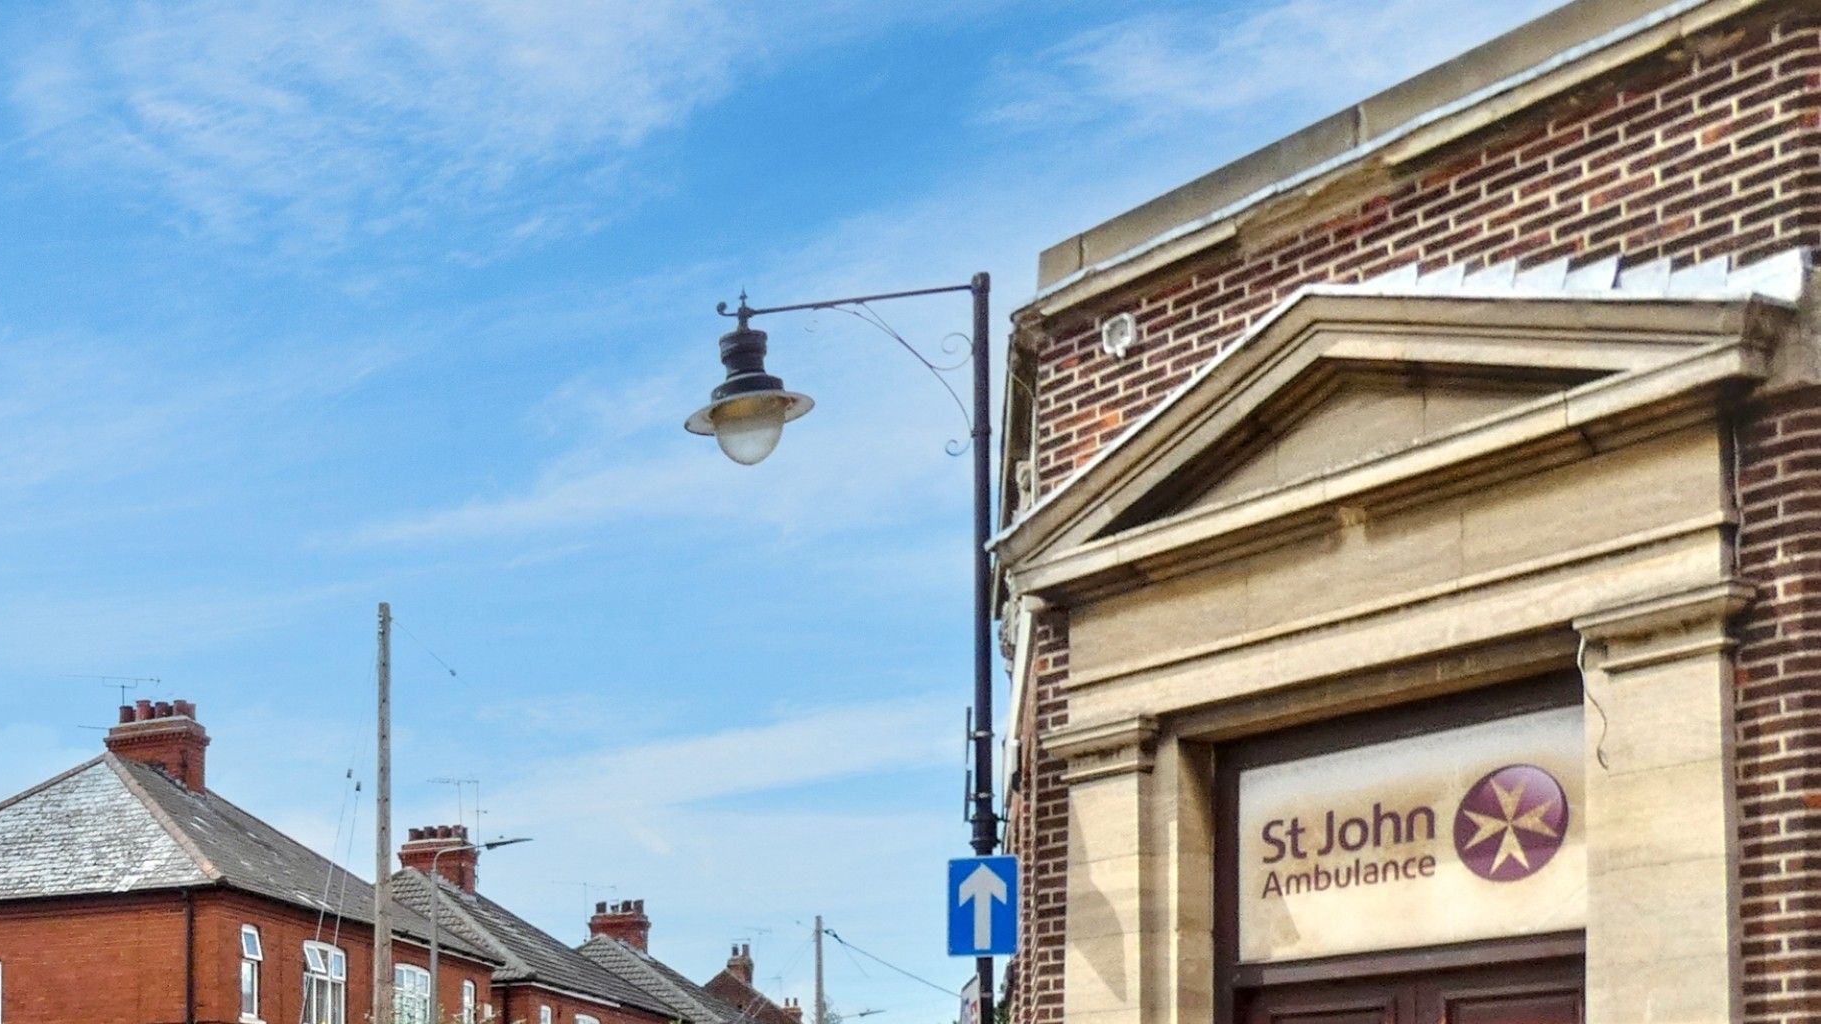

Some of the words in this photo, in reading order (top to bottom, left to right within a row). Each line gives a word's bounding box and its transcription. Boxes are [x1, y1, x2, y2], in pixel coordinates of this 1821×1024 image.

[1262, 818, 1308, 864] St
[1317, 803, 1436, 856] John
[1262, 855, 1437, 899] Ambulance
